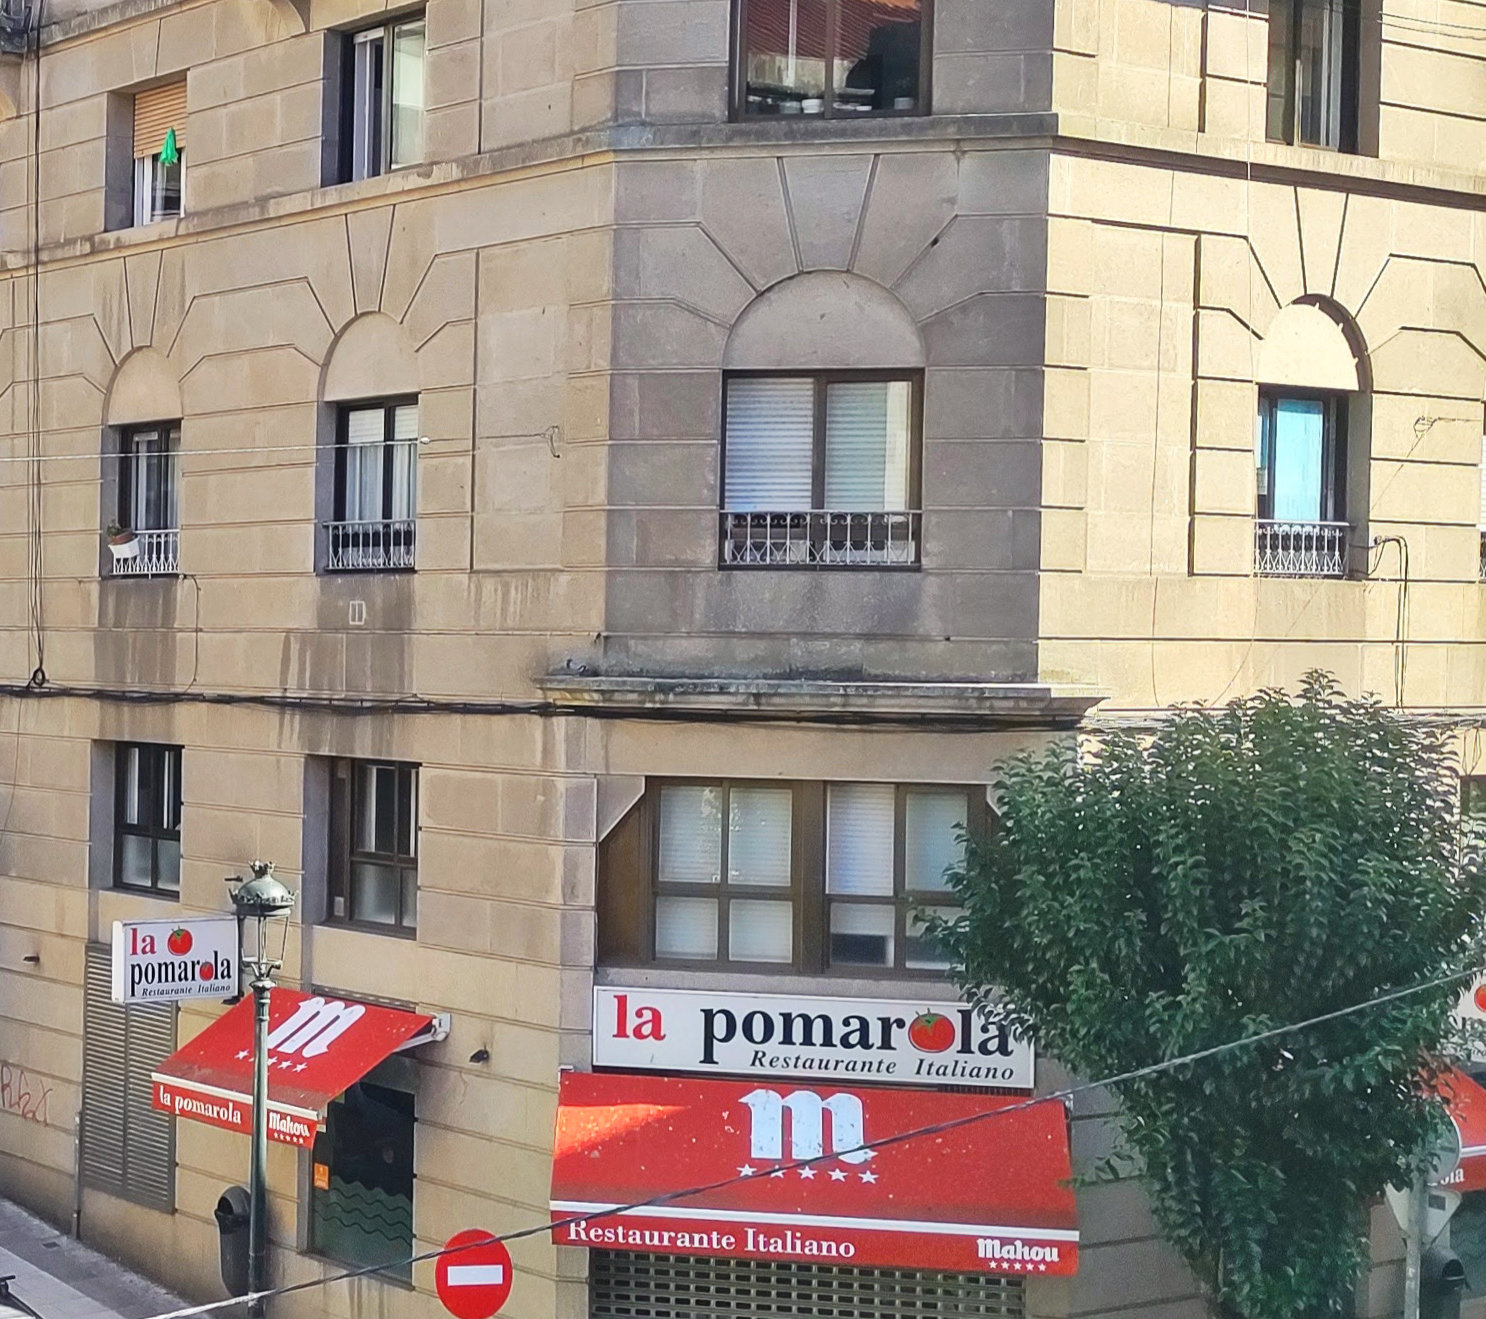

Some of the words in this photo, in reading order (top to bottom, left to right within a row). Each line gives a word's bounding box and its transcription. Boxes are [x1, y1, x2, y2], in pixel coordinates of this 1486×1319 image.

[130, 927, 157, 956] la
[142, 986, 193, 997] Restaurante
[197, 984, 231, 994] Italiano
[612, 994, 667, 1042] la
[749, 1049, 897, 1074] Restaurante
[915, 1058, 1015, 1080] Italiano
[159, 1085, 171, 1106] la
[175, 1095, 242, 1125] pomarola
[269, 1111, 311, 1138] Mahou
[567, 1219, 736, 1250] Restaurante
[744, 1227, 856, 1258] Italiano
[976, 1238, 1060, 1262] Mahou
